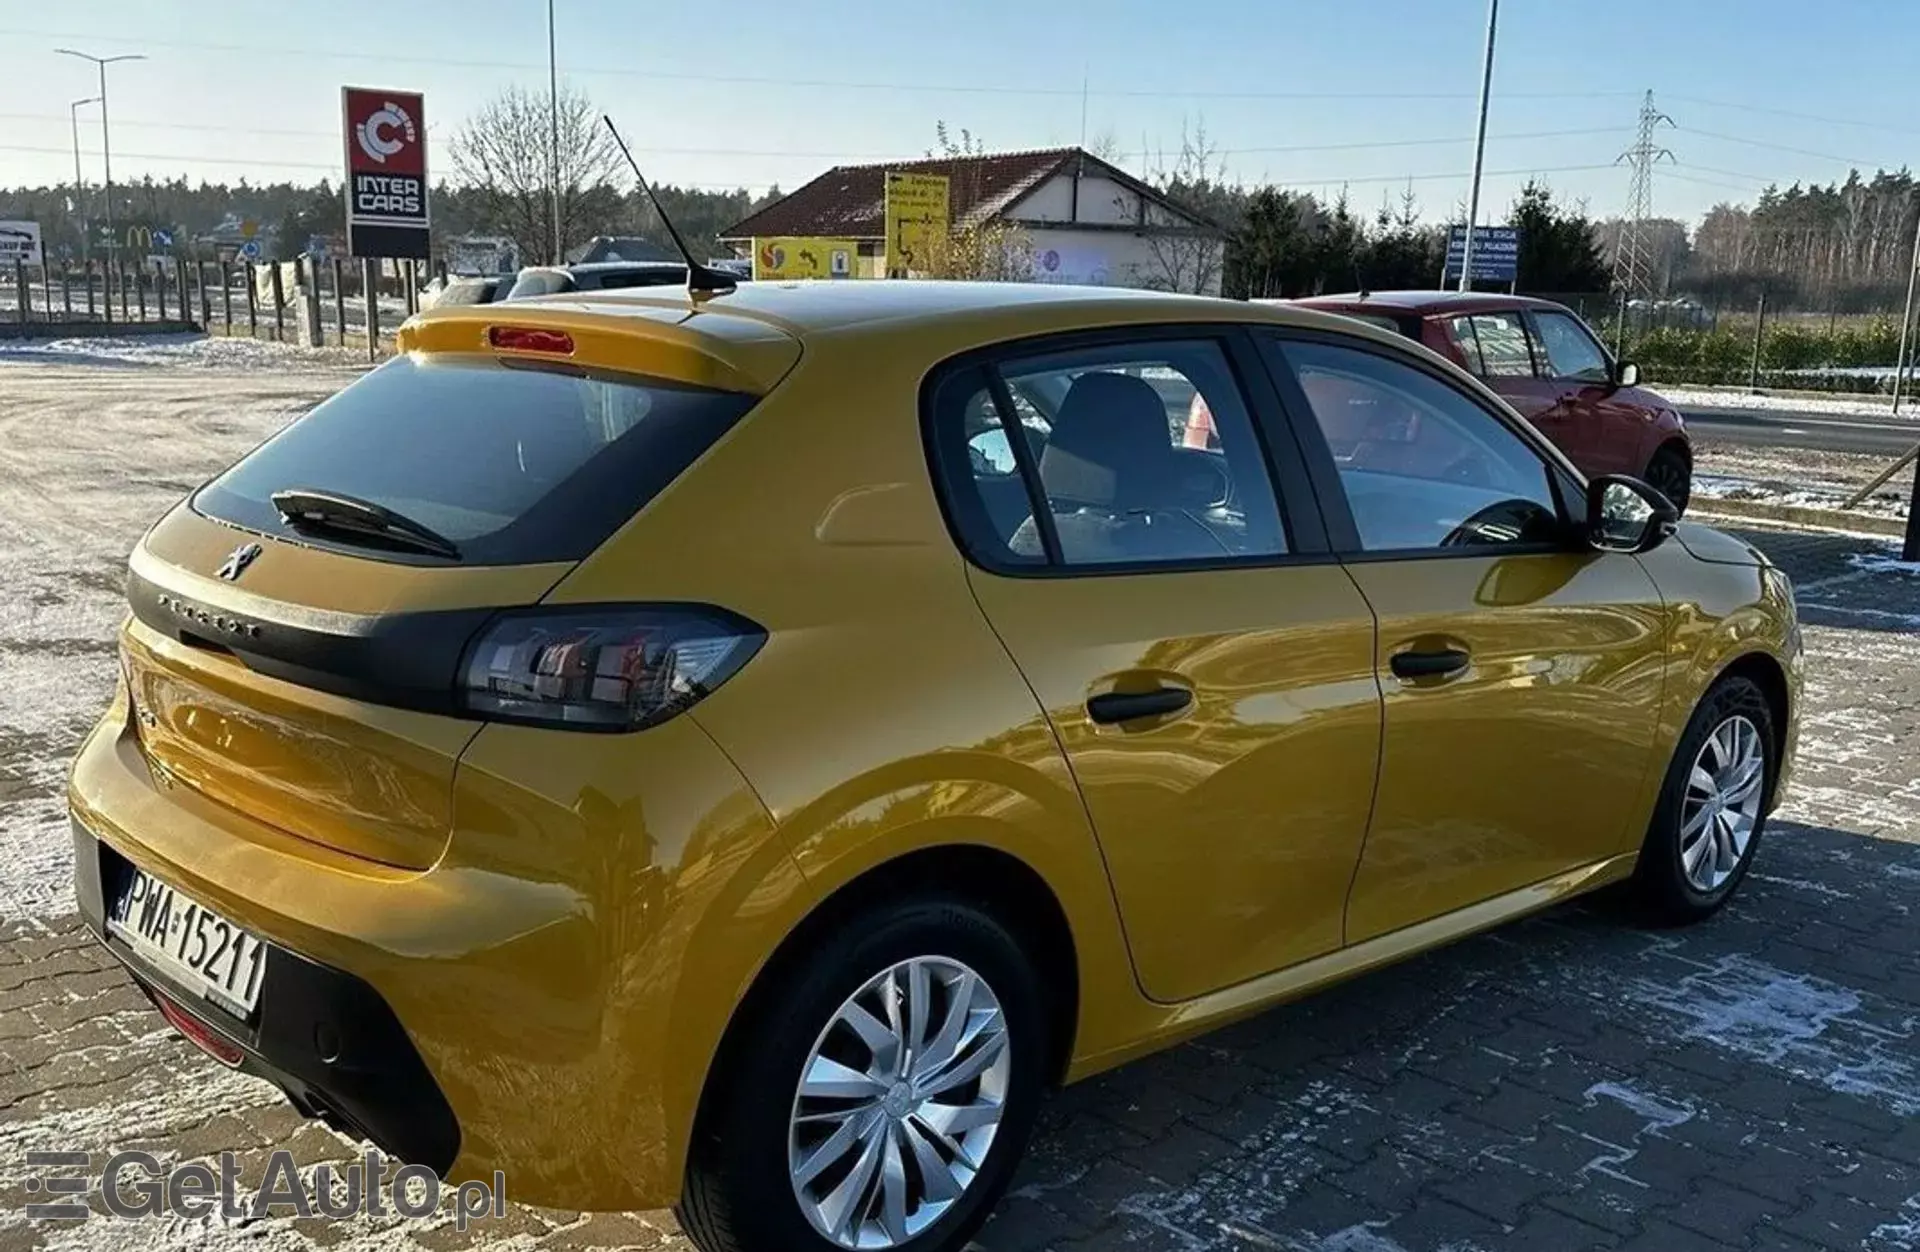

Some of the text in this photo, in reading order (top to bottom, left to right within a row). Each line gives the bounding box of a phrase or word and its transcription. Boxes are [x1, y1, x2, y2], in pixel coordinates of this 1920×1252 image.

[357, 176, 419, 195] INTER
[358, 194, 420, 212] CARS
[158, 594, 260, 638] PEUGEOT
[125, 870, 266, 1001] PWA 15211
